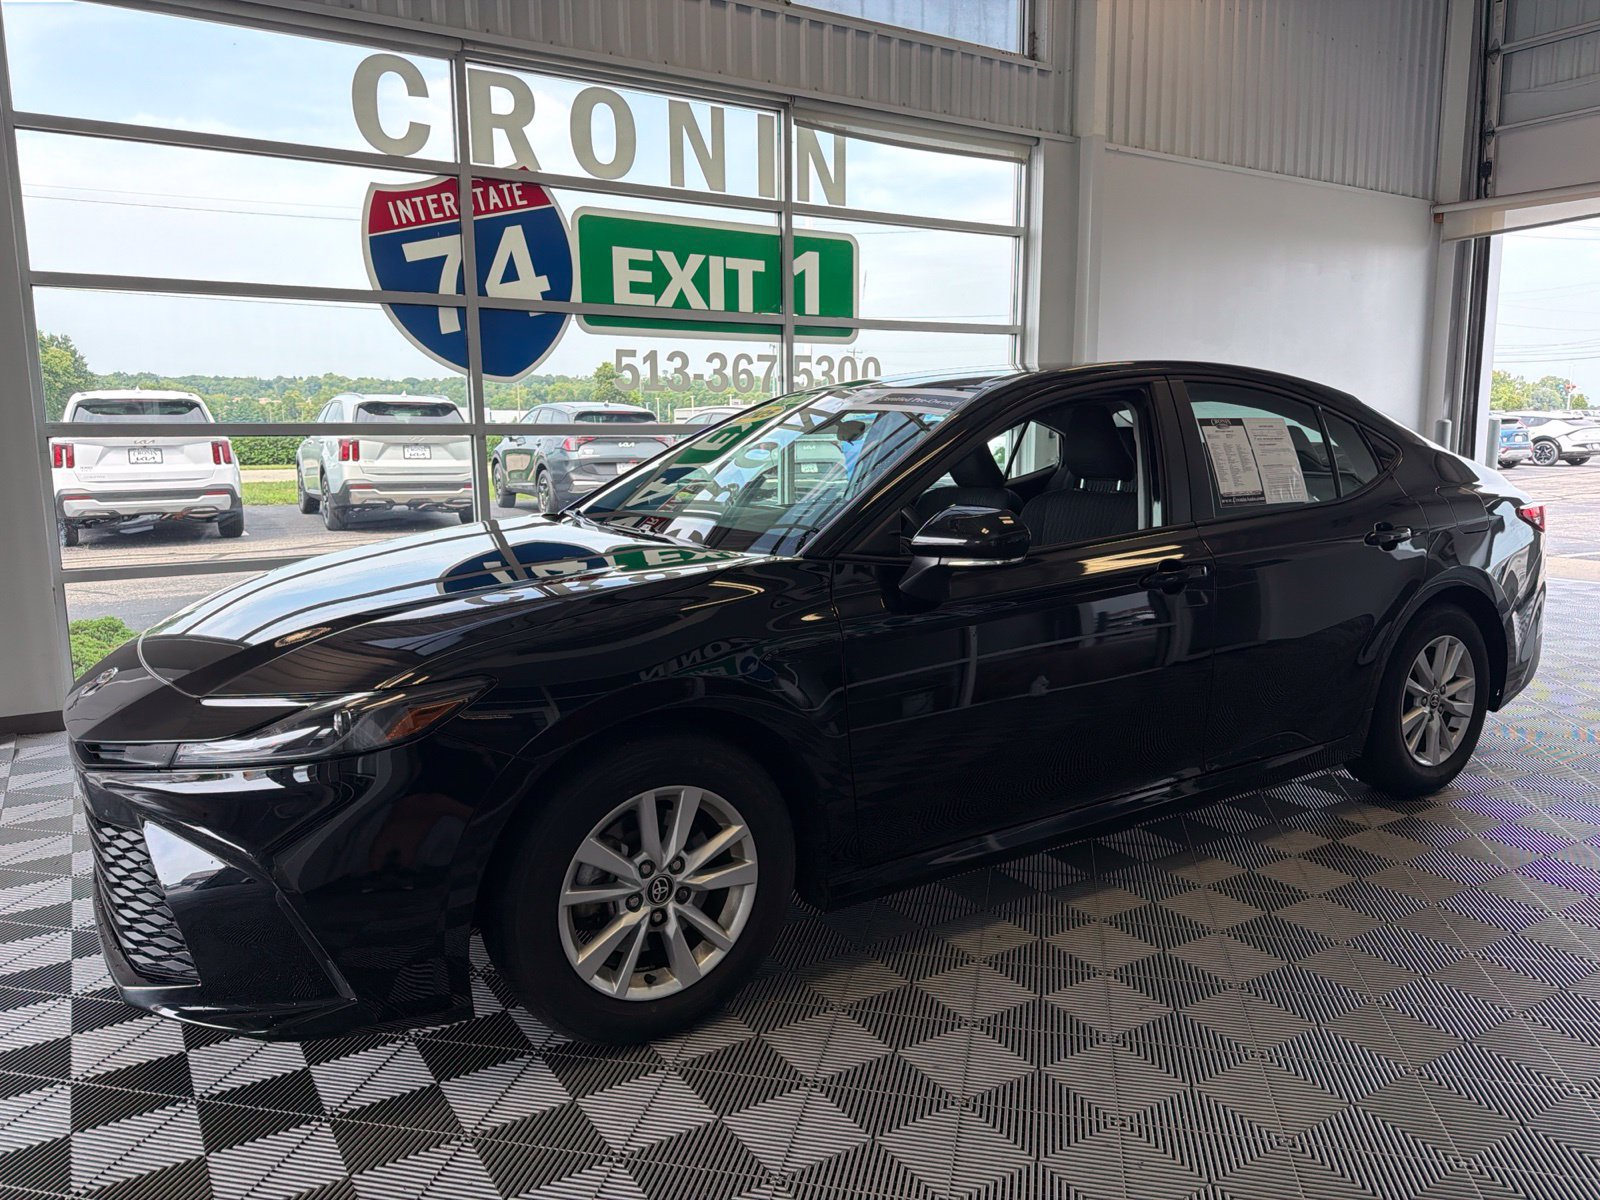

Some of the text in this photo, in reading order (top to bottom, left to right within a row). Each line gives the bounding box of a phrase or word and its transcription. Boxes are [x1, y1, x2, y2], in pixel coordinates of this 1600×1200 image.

[351, 53, 846, 207] CRONIN
[387, 182, 528, 226] INTERTATE
[401, 224, 551, 335] 74
[611, 246, 820, 315] EXIT 1
[614, 348, 882, 394] 513-3675300
